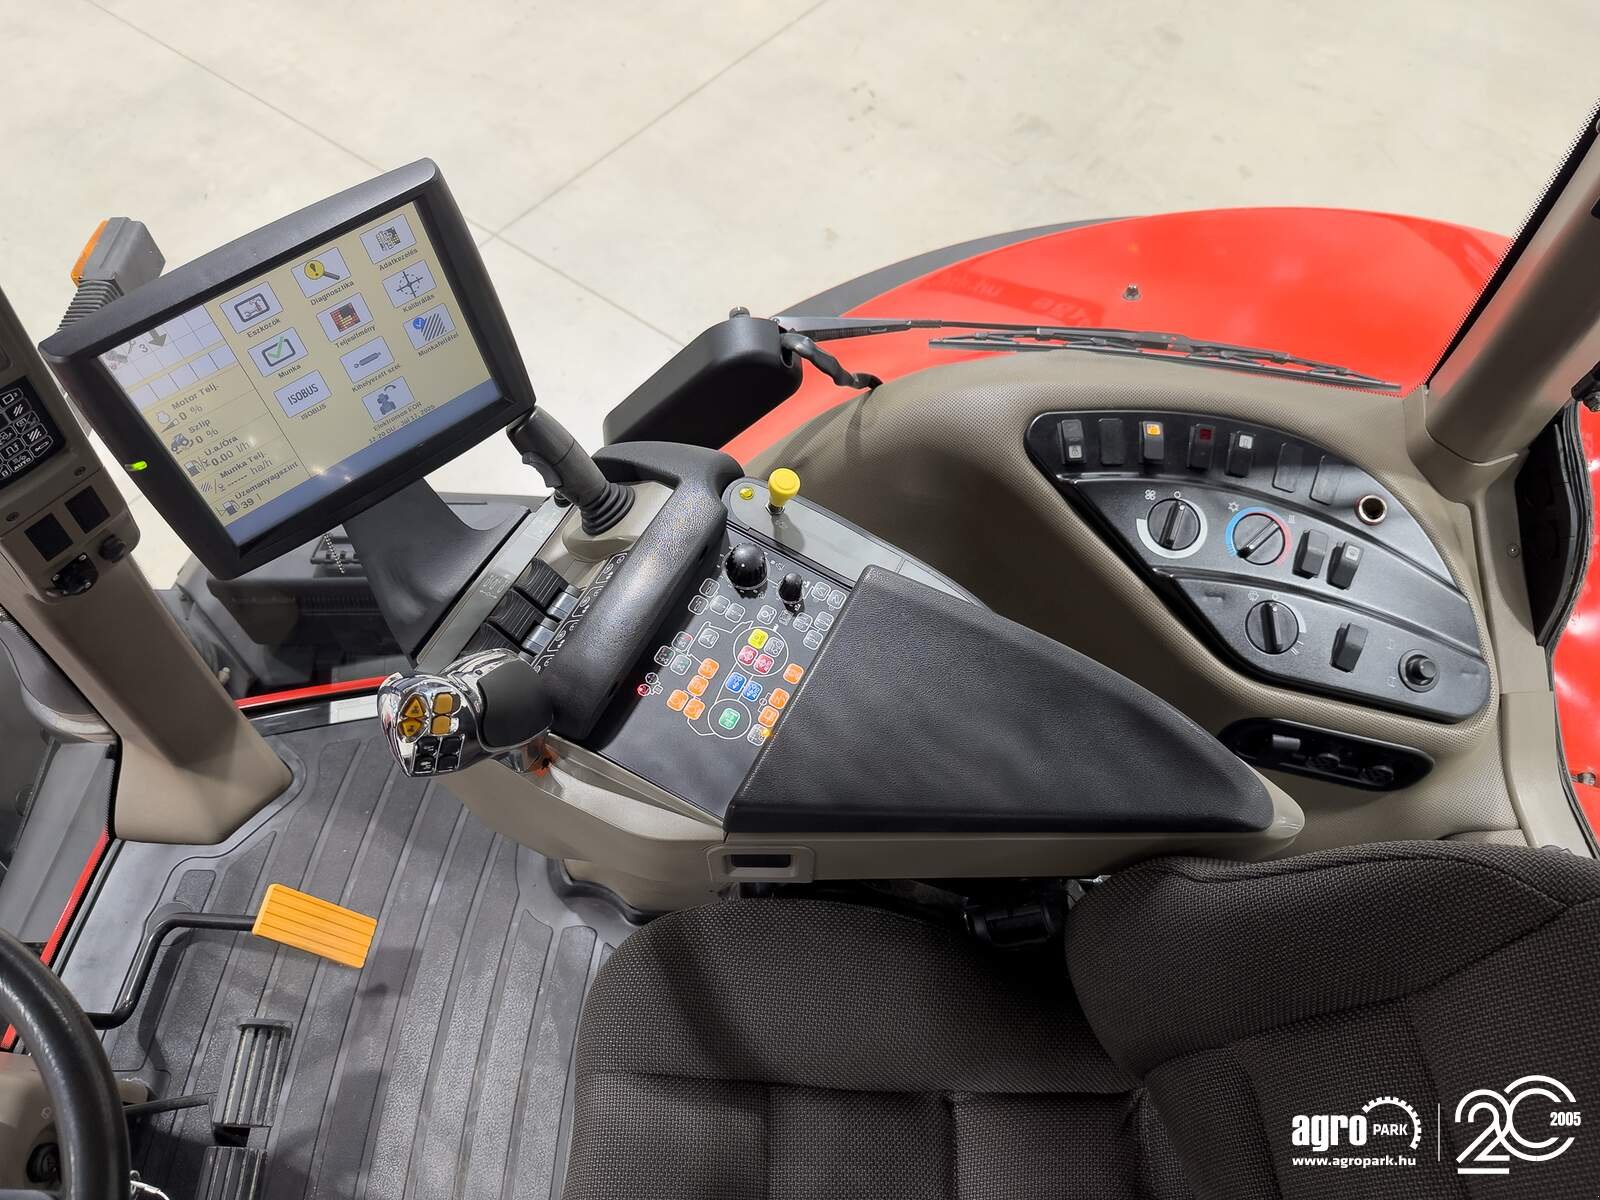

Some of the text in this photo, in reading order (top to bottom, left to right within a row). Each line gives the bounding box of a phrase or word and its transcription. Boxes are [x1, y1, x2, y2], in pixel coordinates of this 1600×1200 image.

[310, 280, 354, 306] Diagnosztika
[138, 344, 148, 352] 3
[278, 364, 302, 379] Munka
[172, 394, 198, 410] Motor
[288, 384, 318, 406] ISOBUS
[178, 412, 188, 420] 0
[300, 403, 327, 420] ISOBUS
[188, 418, 211, 433] Szlip
[194, 436, 204, 444] 0
[14, 457, 31, 470] AUTO
[211, 450, 234, 466] 0.00
[220, 460, 248, 478] Munka
[250, 458, 272, 475] ha/h
[241, 498, 254, 510] 39
